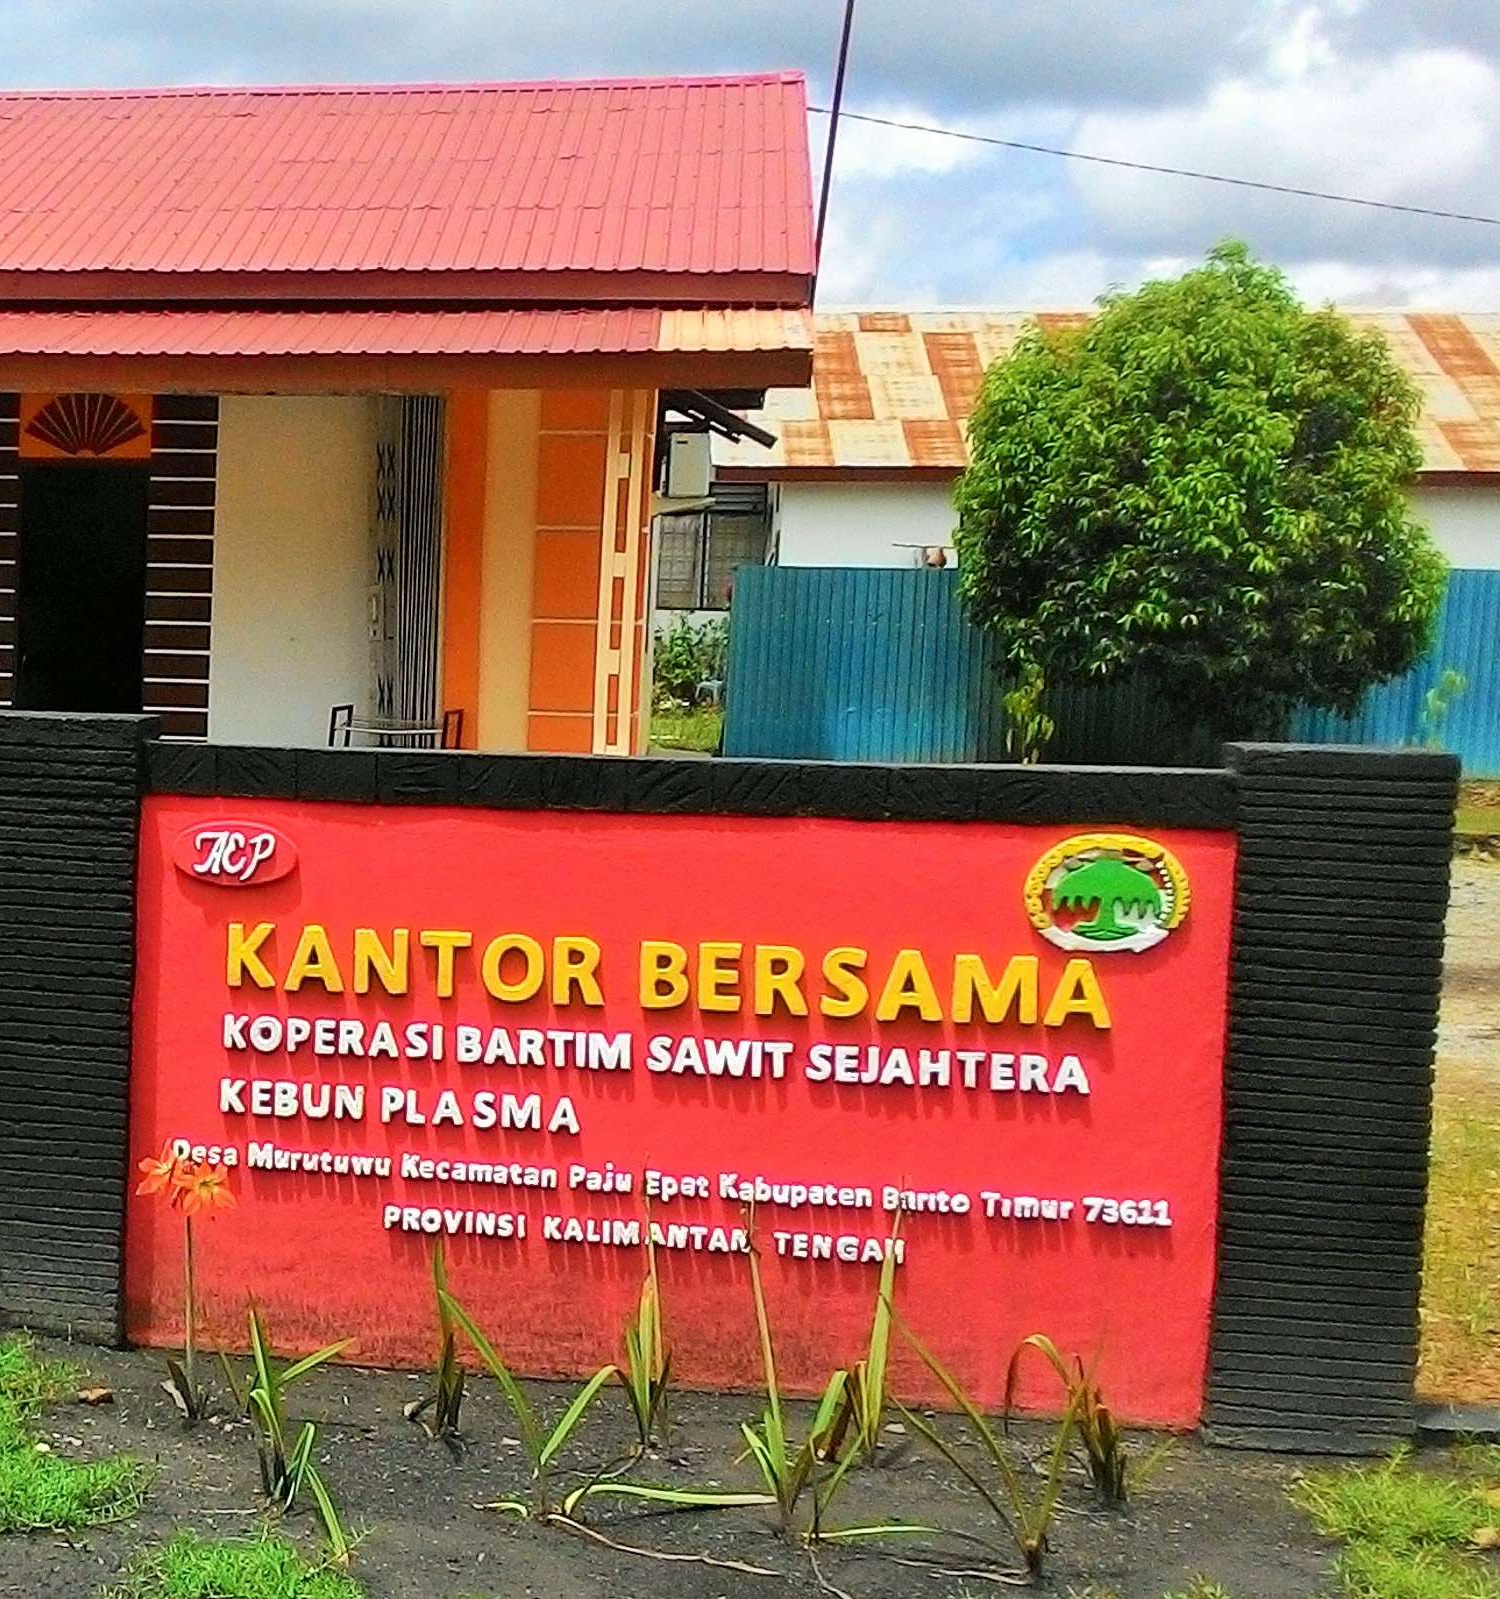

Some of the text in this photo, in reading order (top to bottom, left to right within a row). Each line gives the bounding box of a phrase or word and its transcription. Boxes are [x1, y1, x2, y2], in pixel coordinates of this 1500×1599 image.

[193, 831, 275, 881] AEP
[226, 922, 1112, 1029] KANTOR BERSAMA
[223, 1014, 1091, 1095] KOPERASI BARTIM SAWIT SEJAHTERA
[219, 1078, 581, 1134] KEBUN PLASMA
[173, 1139, 238, 1166] Desa
[247, 1141, 392, 1177] Murutuwu
[401, 1152, 557, 1189] Kecamatan
[569, 1161, 632, 1193] Paju
[645, 1170, 709, 1202] Epat
[718, 1173, 873, 1208] Kabupaten
[980, 1191, 1075, 1219] Timur
[1082, 1197, 1172, 1227] 73611
[384, 1205, 526, 1239] PROVINSI
[543, 1215, 751, 1254] KALIMANTAN
